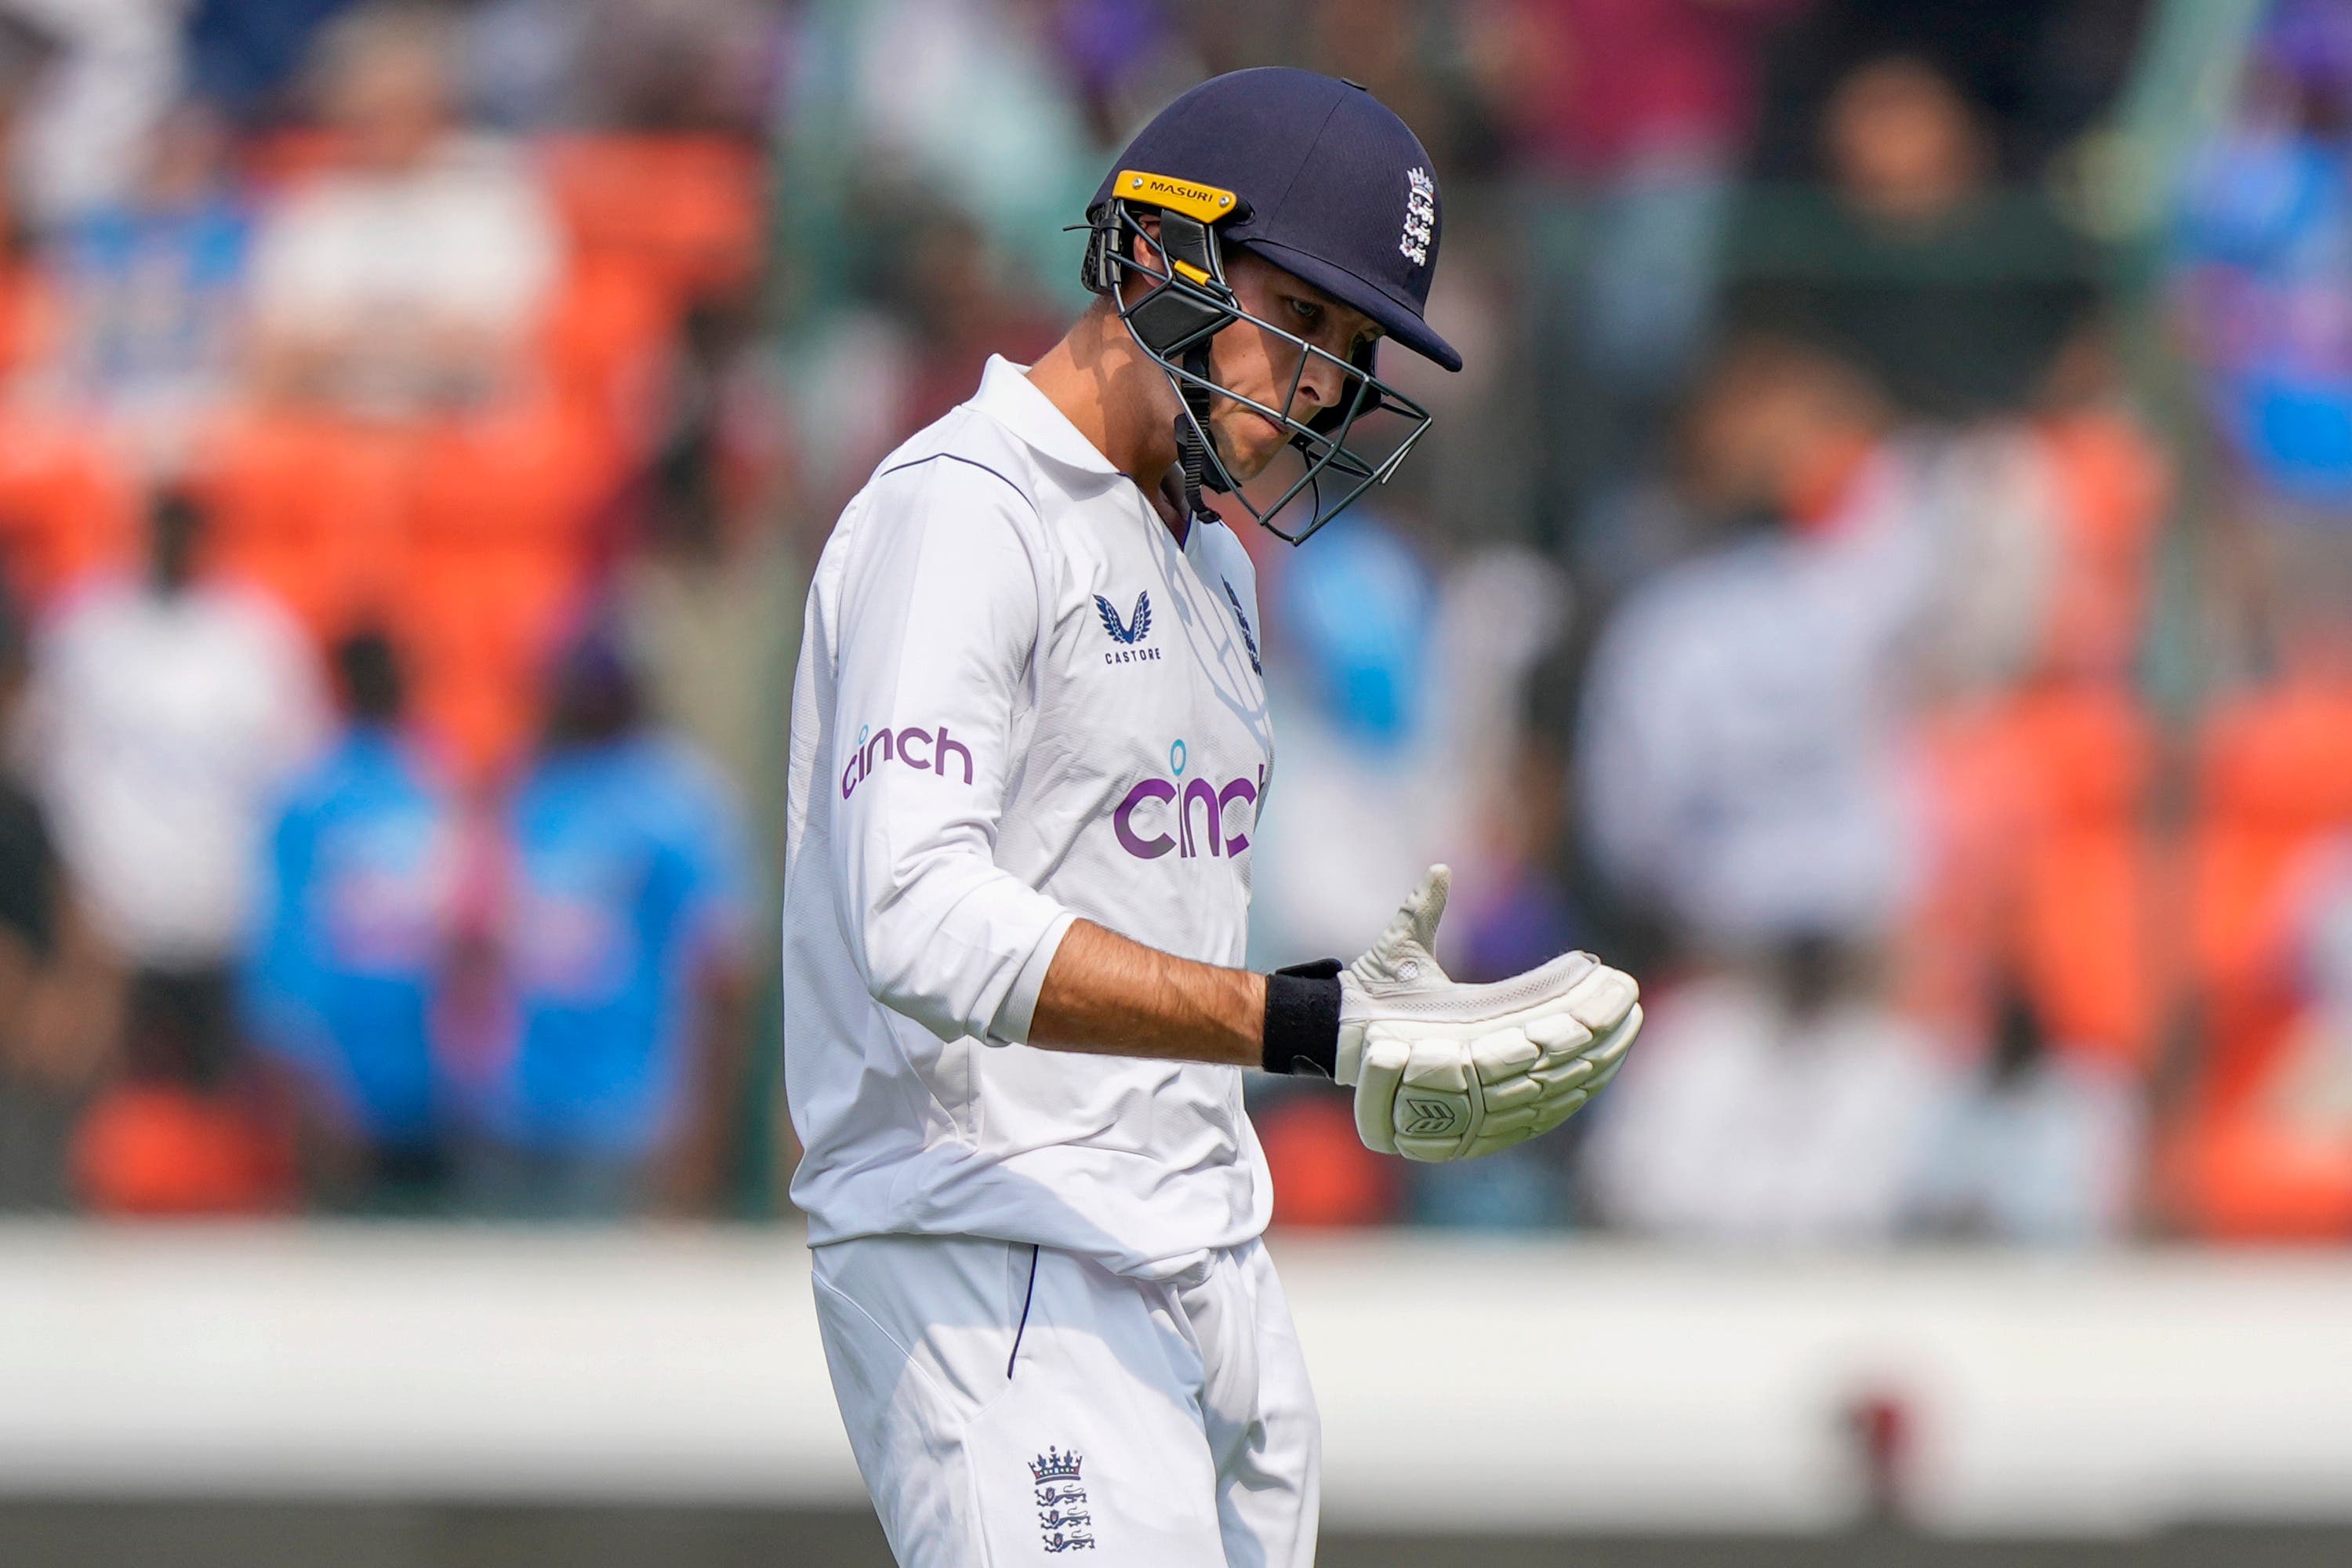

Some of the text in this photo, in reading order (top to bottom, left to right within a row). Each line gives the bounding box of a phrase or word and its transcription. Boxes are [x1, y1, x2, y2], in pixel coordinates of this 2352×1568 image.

[1149, 181, 1214, 202] MASURI
[1105, 648, 1161, 665] CASTORE
[842, 724, 974, 800] cinch
[1113, 739, 1265, 859] cinc
